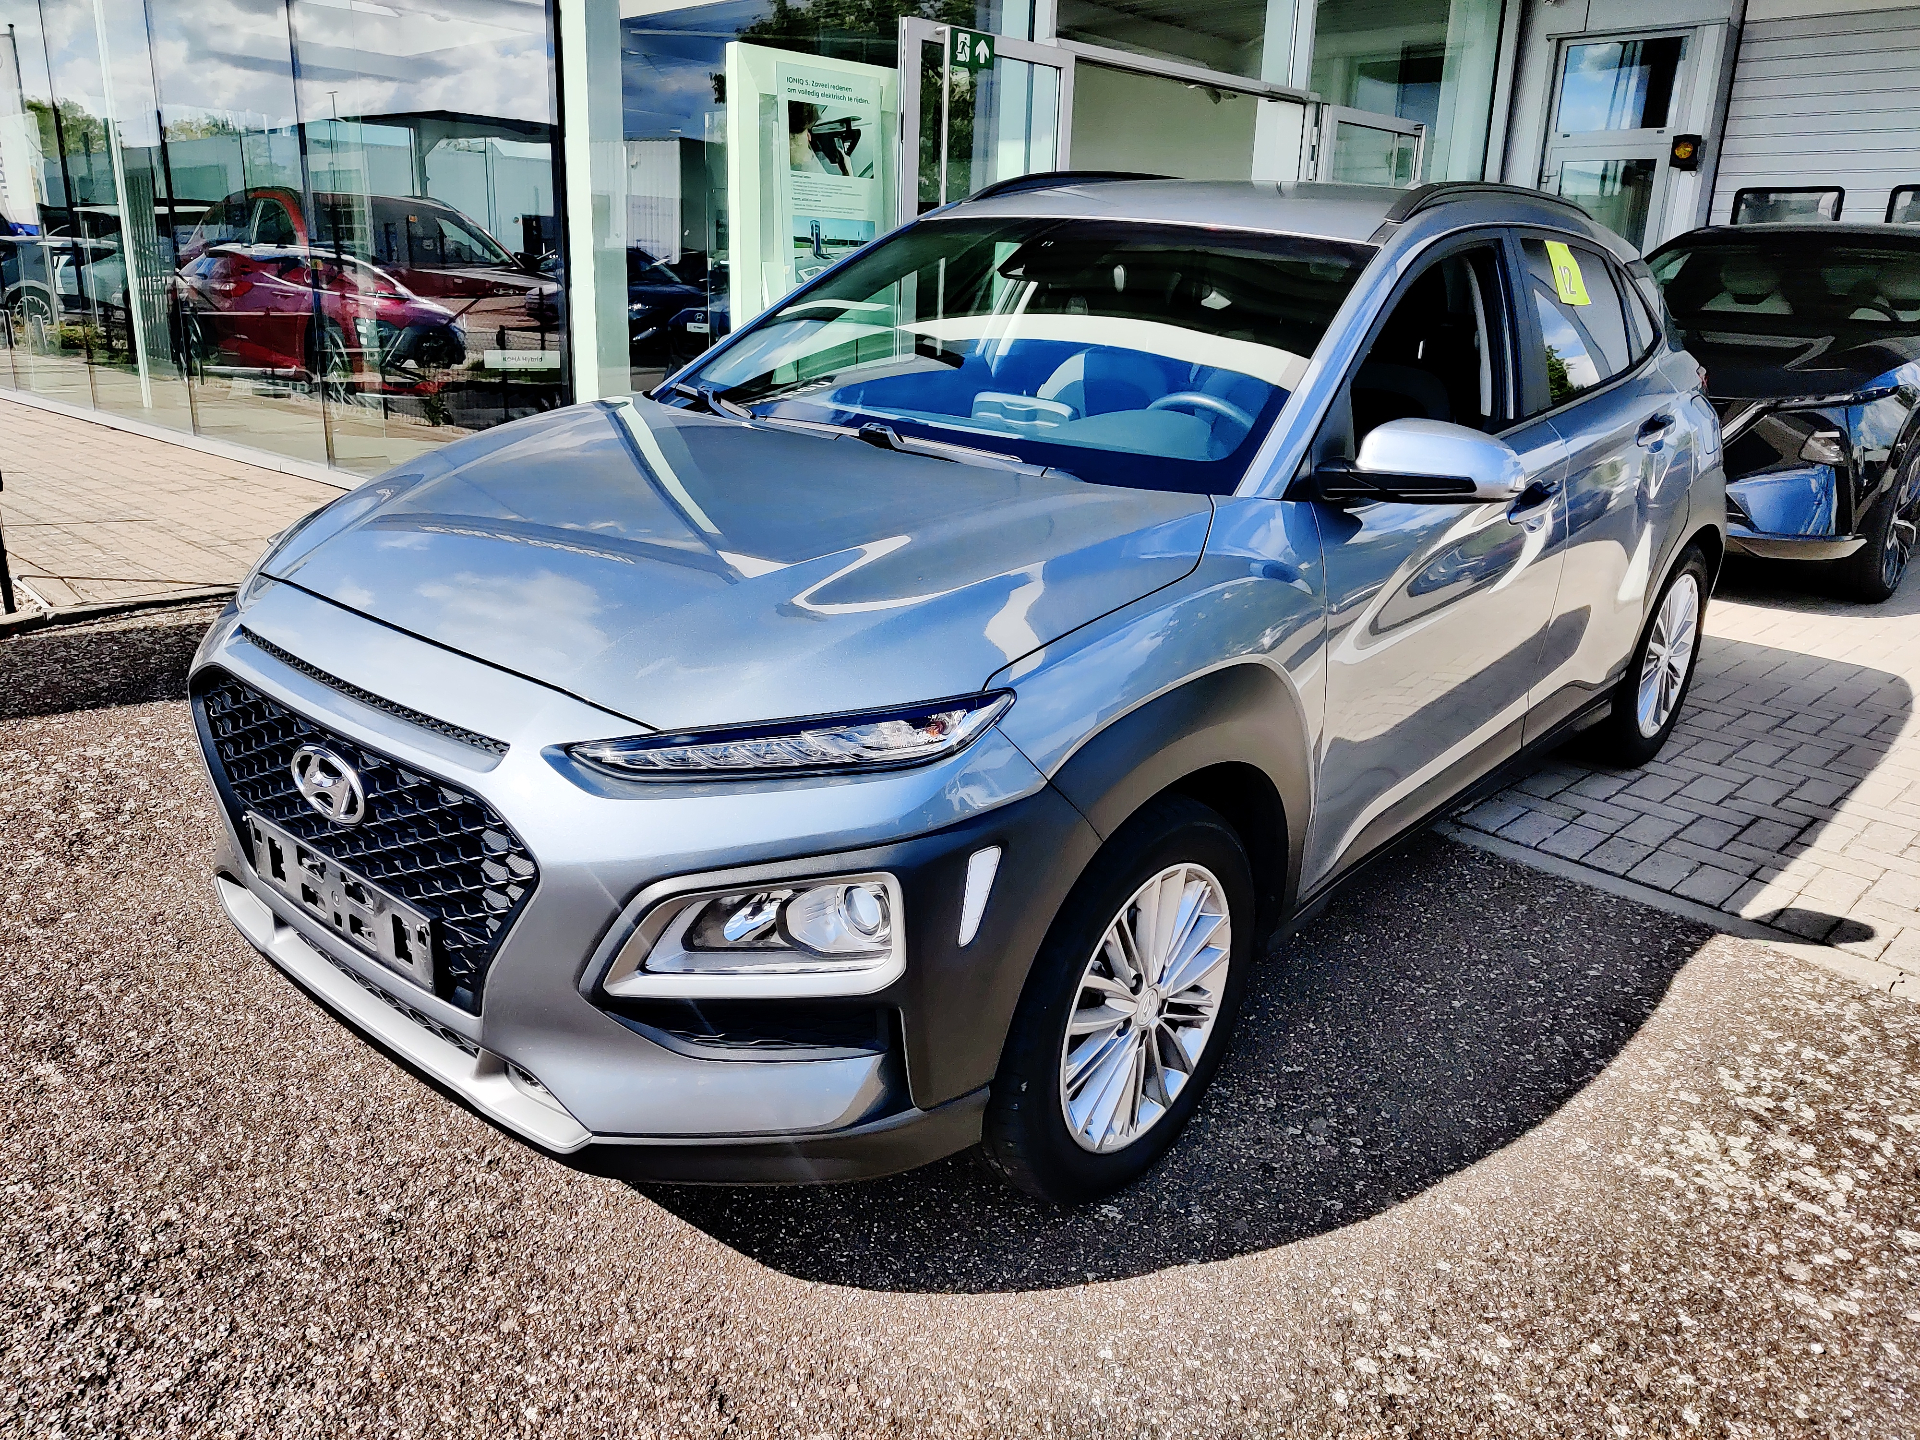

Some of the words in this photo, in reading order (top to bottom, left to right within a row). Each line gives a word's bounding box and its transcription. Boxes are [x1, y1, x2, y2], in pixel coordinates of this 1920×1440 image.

[786, 76, 804, 85] IONIQ
[811, 80, 830, 89] Zoveel
[830, 83, 853, 92] redenen
[797, 87, 820, 98] volledig
[820, 91, 847, 101] elektrisch
[853, 96, 870, 105] rijden.
[1557, 264, 1577, 295] 12
